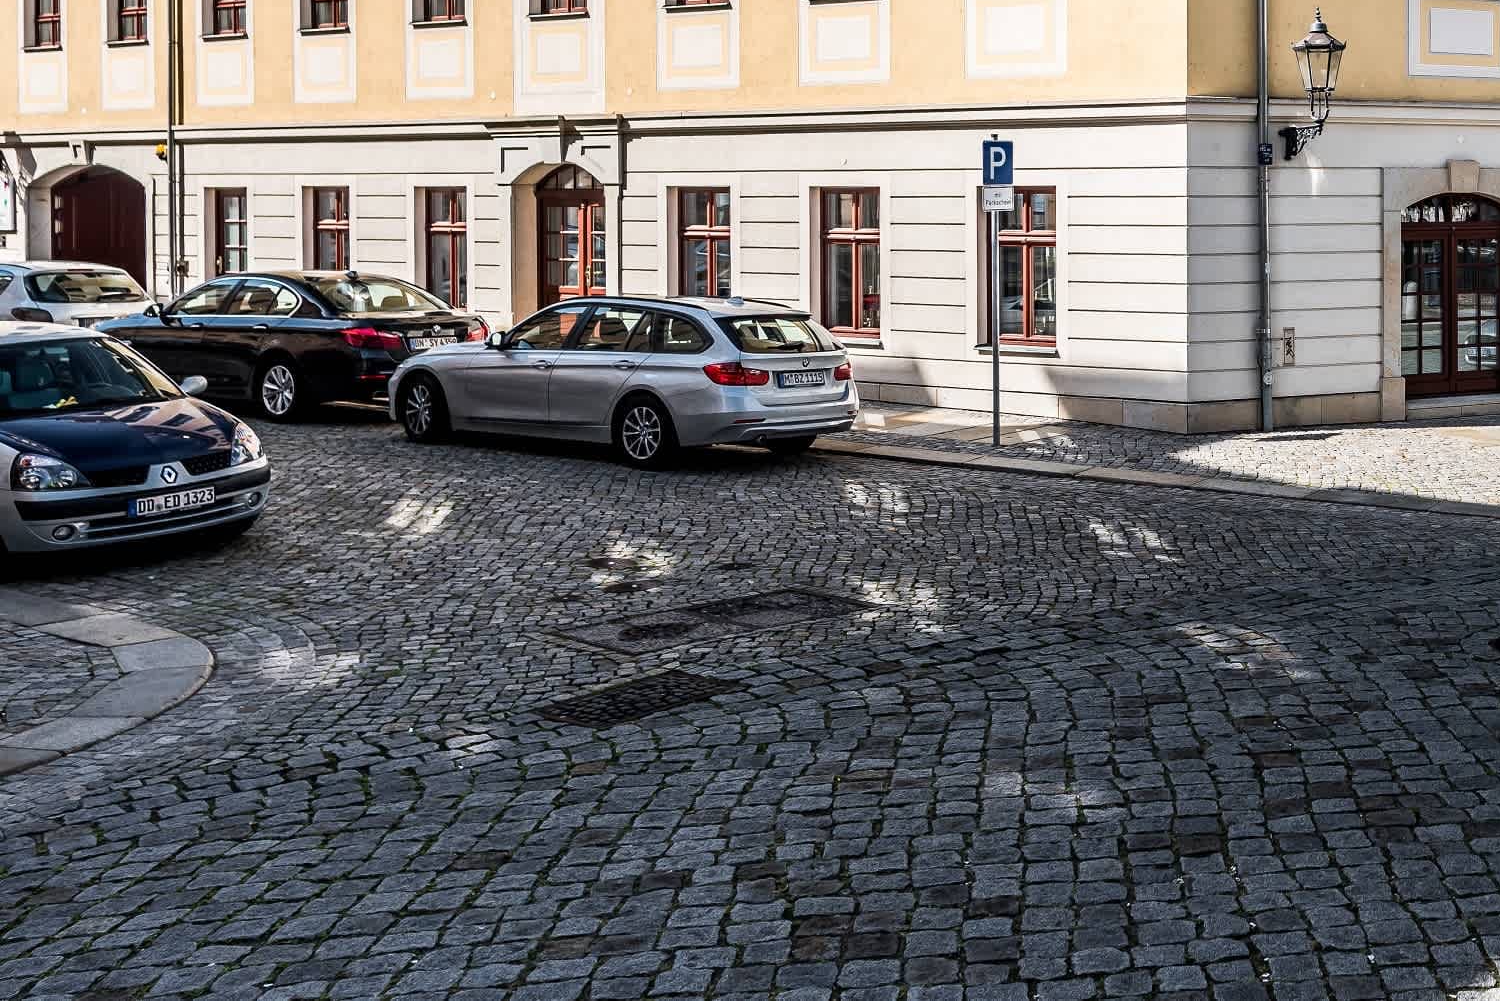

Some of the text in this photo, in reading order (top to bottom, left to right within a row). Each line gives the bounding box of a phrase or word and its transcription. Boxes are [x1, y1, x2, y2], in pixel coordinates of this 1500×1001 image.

[990, 146, 1006, 180] P
[138, 489, 214, 513] DD ED 1323
